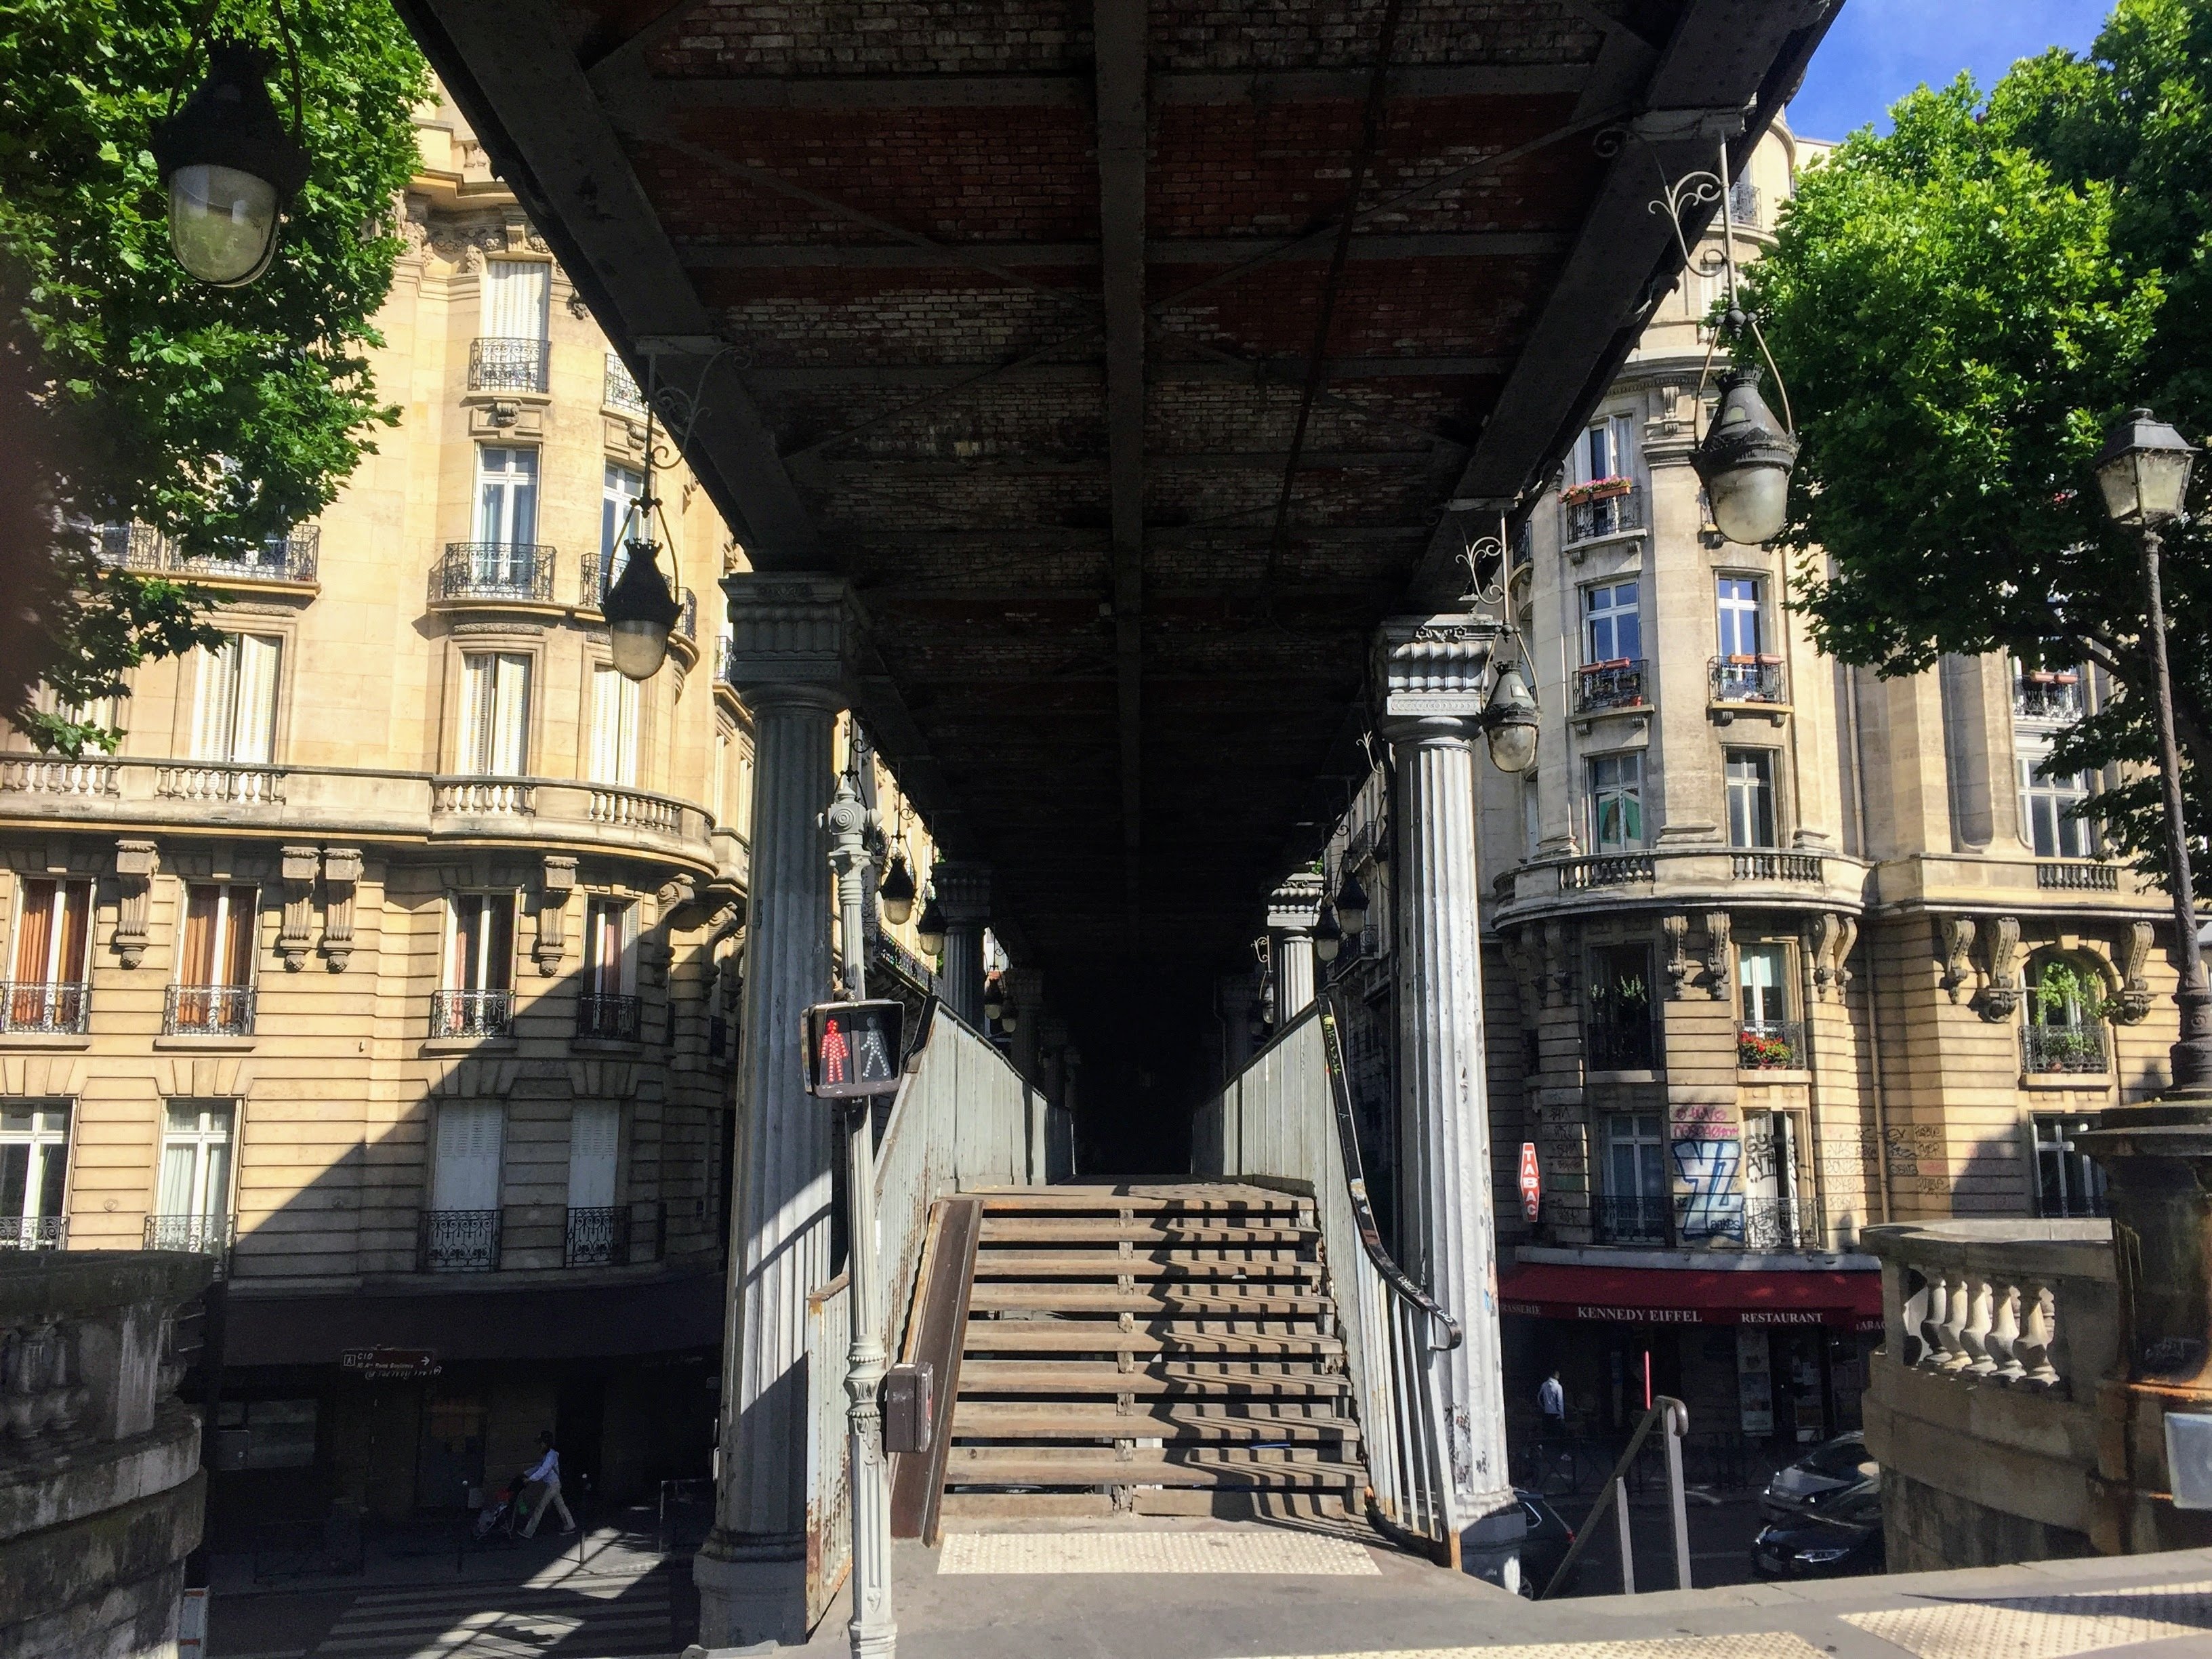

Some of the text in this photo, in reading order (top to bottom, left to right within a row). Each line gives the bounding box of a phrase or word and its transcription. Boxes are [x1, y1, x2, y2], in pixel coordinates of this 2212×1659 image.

[1522, 1150, 1538, 1215] TABAC
[1500, 1304, 1541, 1316] RASSERIE
[1578, 1306, 1645, 1321] KENNEDY
[1650, 1309, 1702, 1322] EIFFEL
[1741, 1313, 1823, 1323] RESTAURANT
